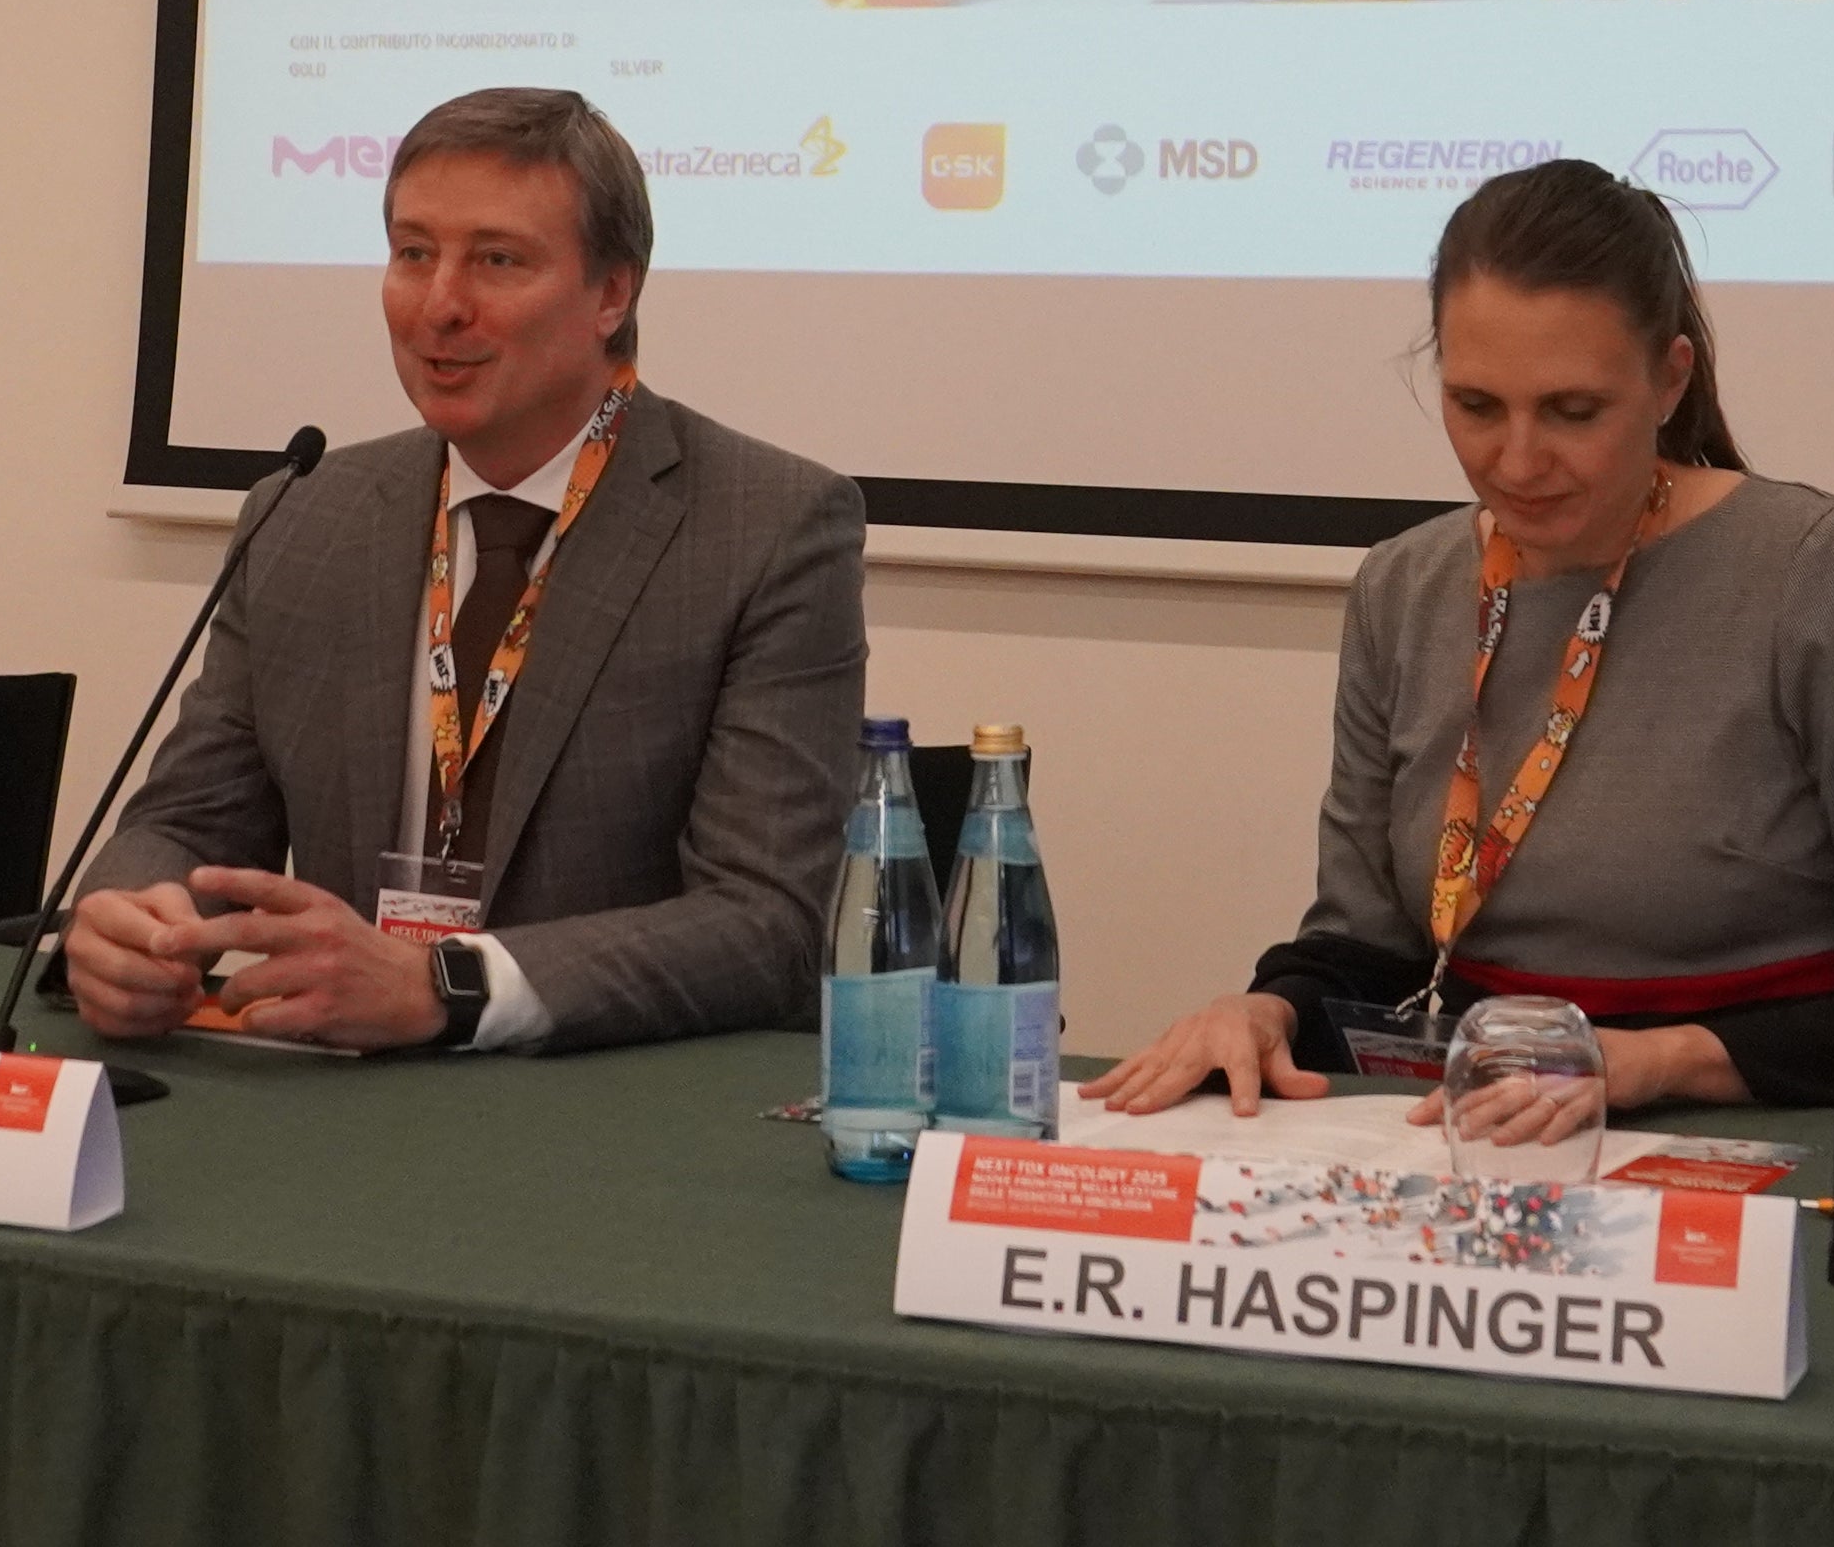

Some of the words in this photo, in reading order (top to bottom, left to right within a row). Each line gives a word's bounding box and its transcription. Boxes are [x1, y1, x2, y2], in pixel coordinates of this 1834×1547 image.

[290, 35, 318, 49] CON
[340, 34, 432, 49] CONTRIBUTO
[436, 33, 557, 48] INCONDIZIONATO
[289, 62, 327, 78] GOLD
[610, 60, 663, 76] SILVER
[636, 146, 801, 176] straZeneca
[930, 155, 995, 178] GSK
[1159, 139, 1258, 179] MSD
[1326, 139, 1562, 170] REGENERON
[1657, 153, 1754, 184] Roche
[1350, 176, 1427, 190] SCIENCE
[1000, 1247, 1145, 1322] E.R.
[1176, 1262, 1666, 1369] HASPINGER
